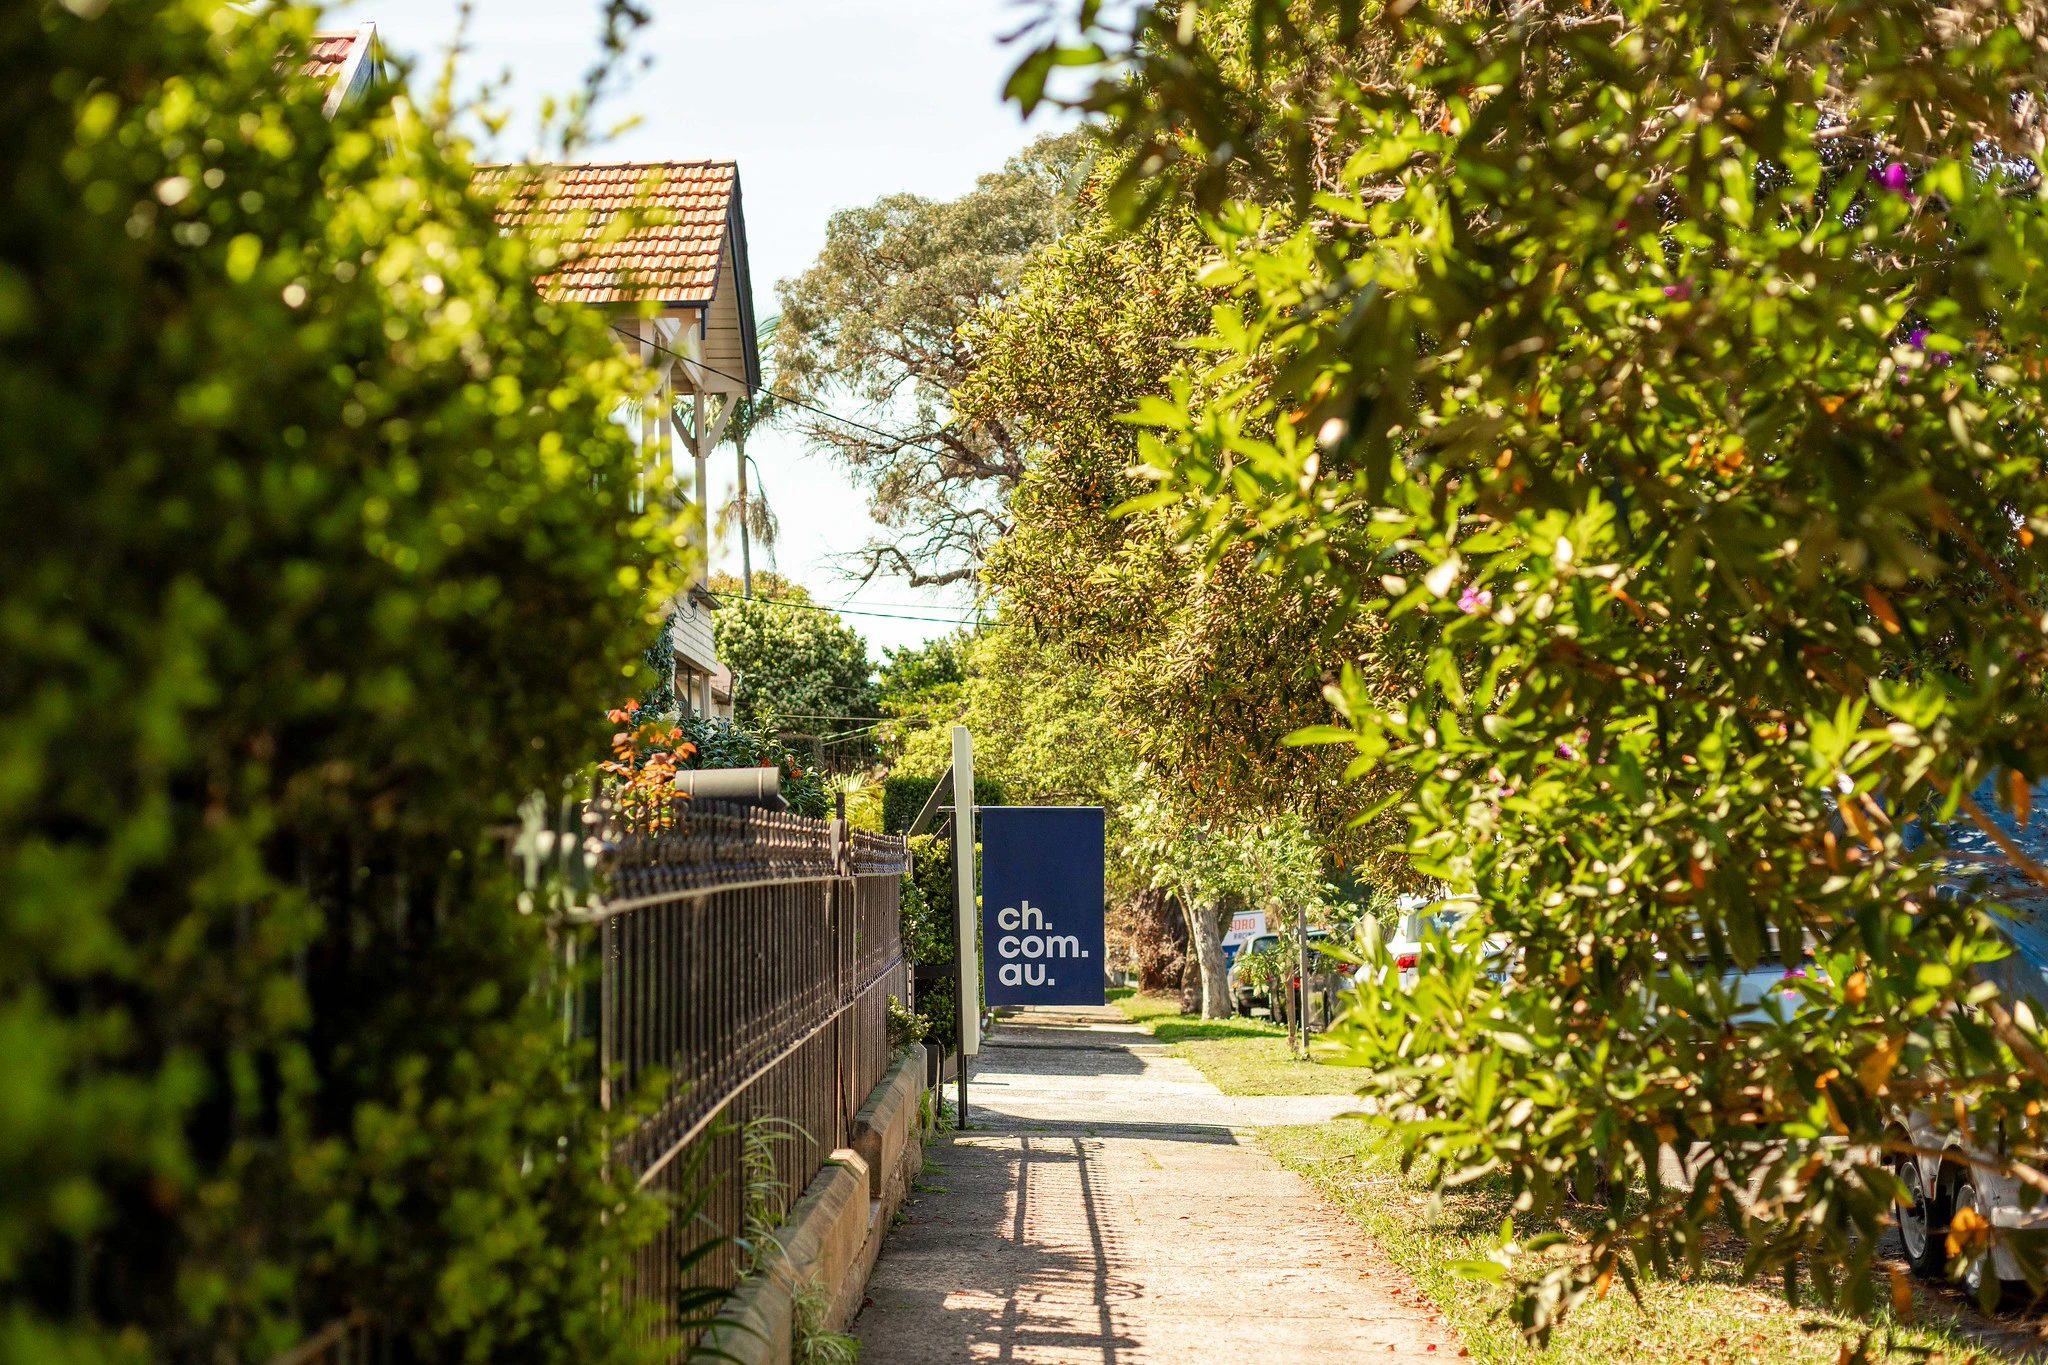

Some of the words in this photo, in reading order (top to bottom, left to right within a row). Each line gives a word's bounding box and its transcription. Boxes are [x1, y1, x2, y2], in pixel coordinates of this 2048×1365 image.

[997, 900, 1053, 931] ch.
[998, 935, 1090, 959] com.
[998, 963, 1056, 987] au.
